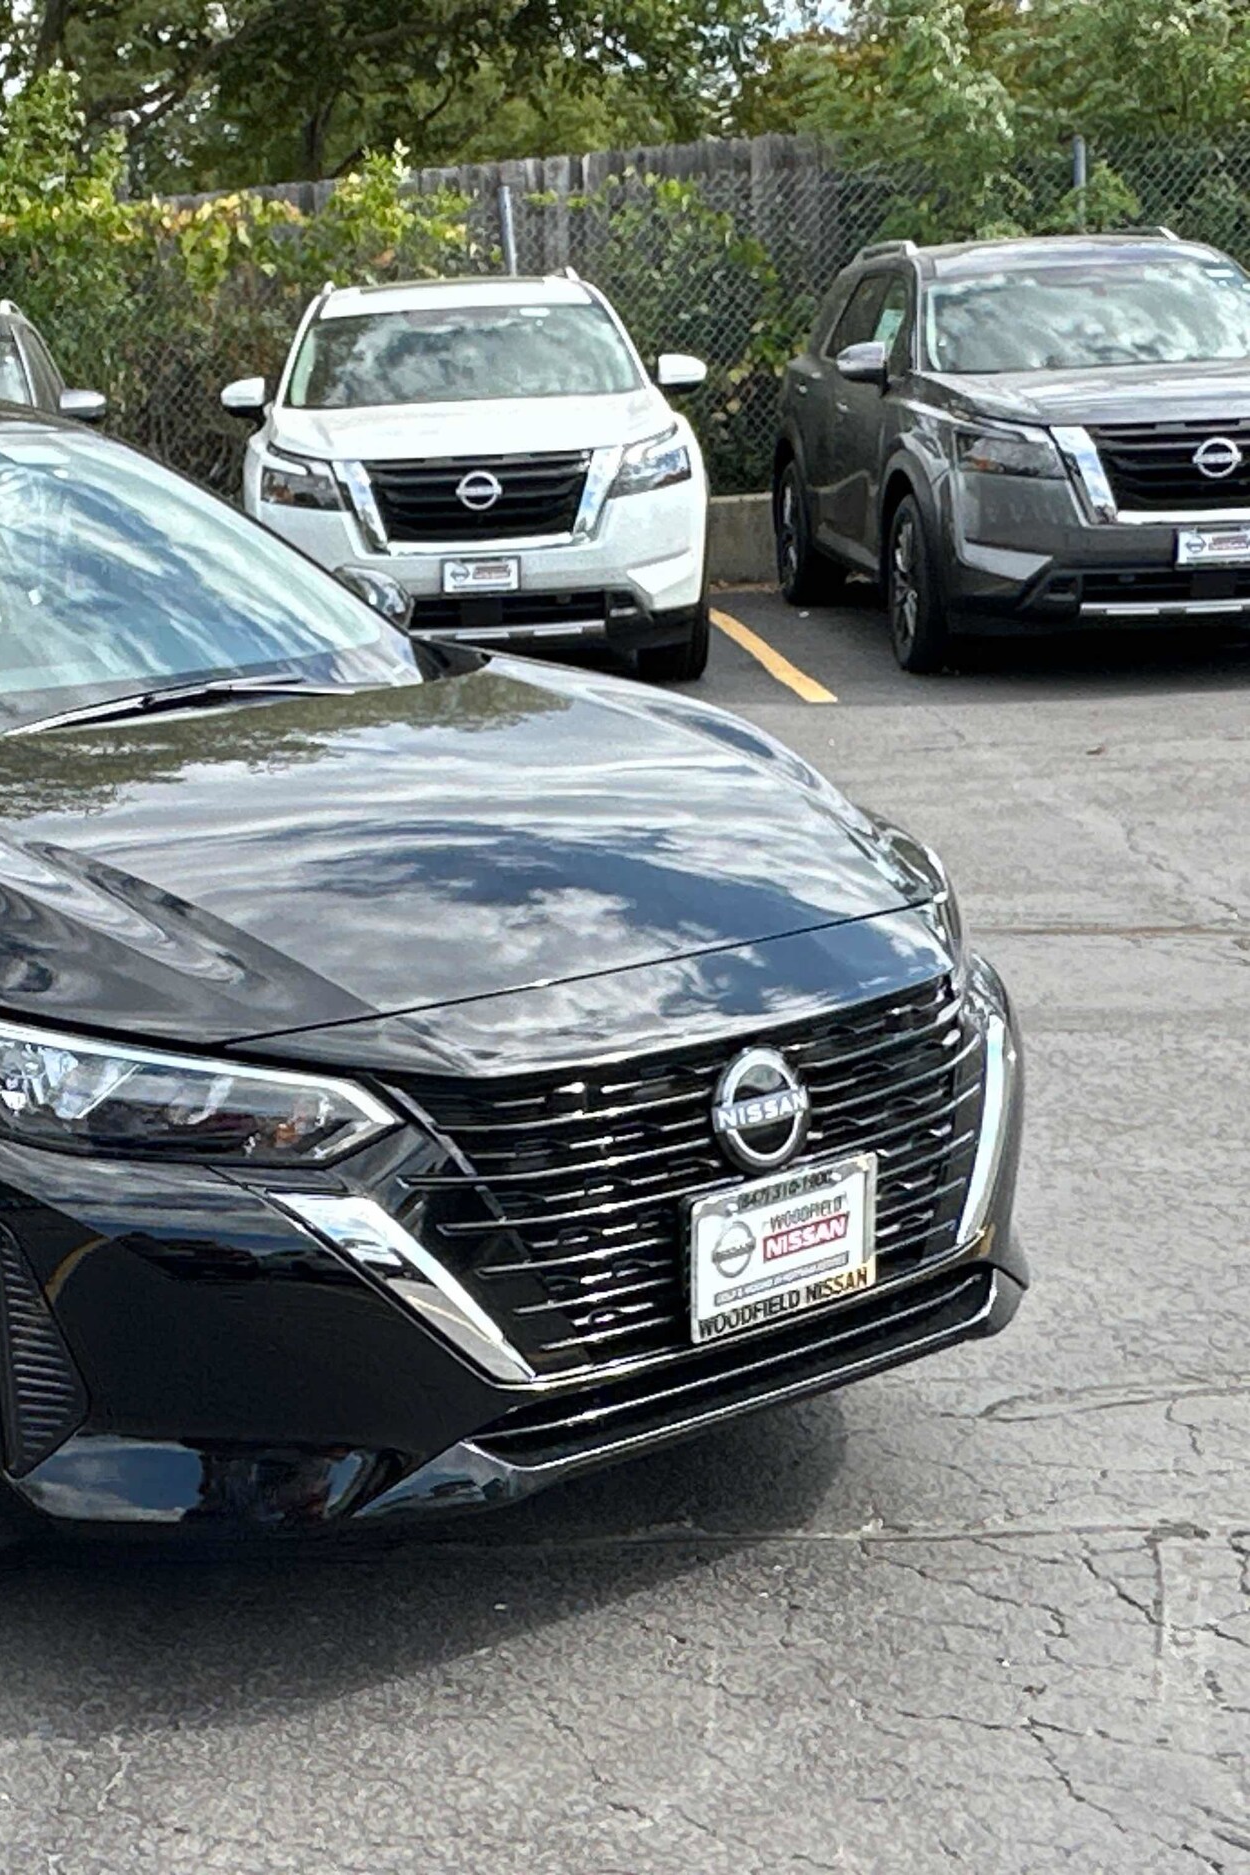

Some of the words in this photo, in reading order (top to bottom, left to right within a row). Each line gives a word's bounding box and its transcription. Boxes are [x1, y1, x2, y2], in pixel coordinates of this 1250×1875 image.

[717, 1086, 807, 1128] NISSAN
[770, 1195, 842, 1233] WOODFIELD
[766, 1217, 846, 1259] NISSAN
[698, 1290, 801, 1338] WOODFIELD
[807, 1267, 868, 1303] NISSAN
